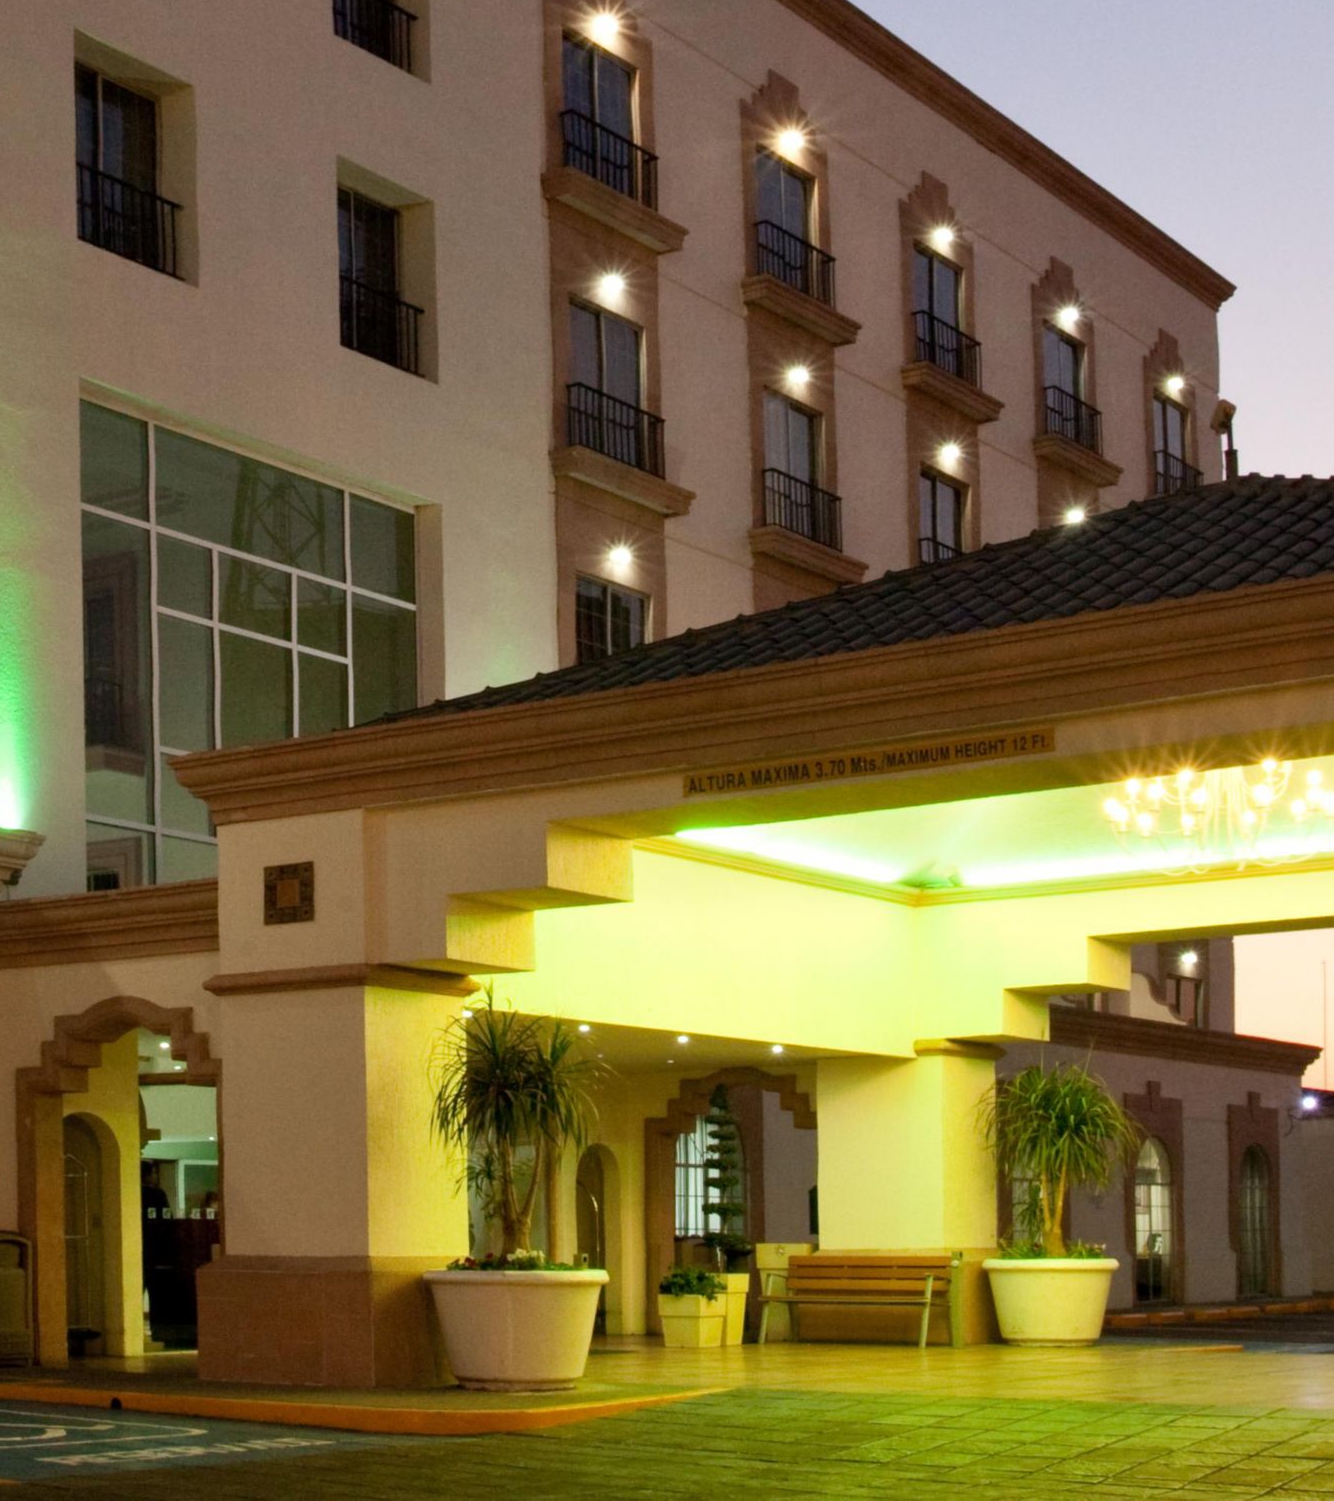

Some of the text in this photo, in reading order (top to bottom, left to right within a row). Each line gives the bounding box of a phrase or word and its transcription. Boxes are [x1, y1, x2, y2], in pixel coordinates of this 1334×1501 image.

[688, 772, 747, 794] ALTURA
[751, 763, 811, 786] MAXIMA
[815, 758, 846, 779] 3.70
[955, 739, 1006, 758] HEIGHT
[1012, 736, 1027, 752] 12
[1031, 734, 1050, 750] Ft.
